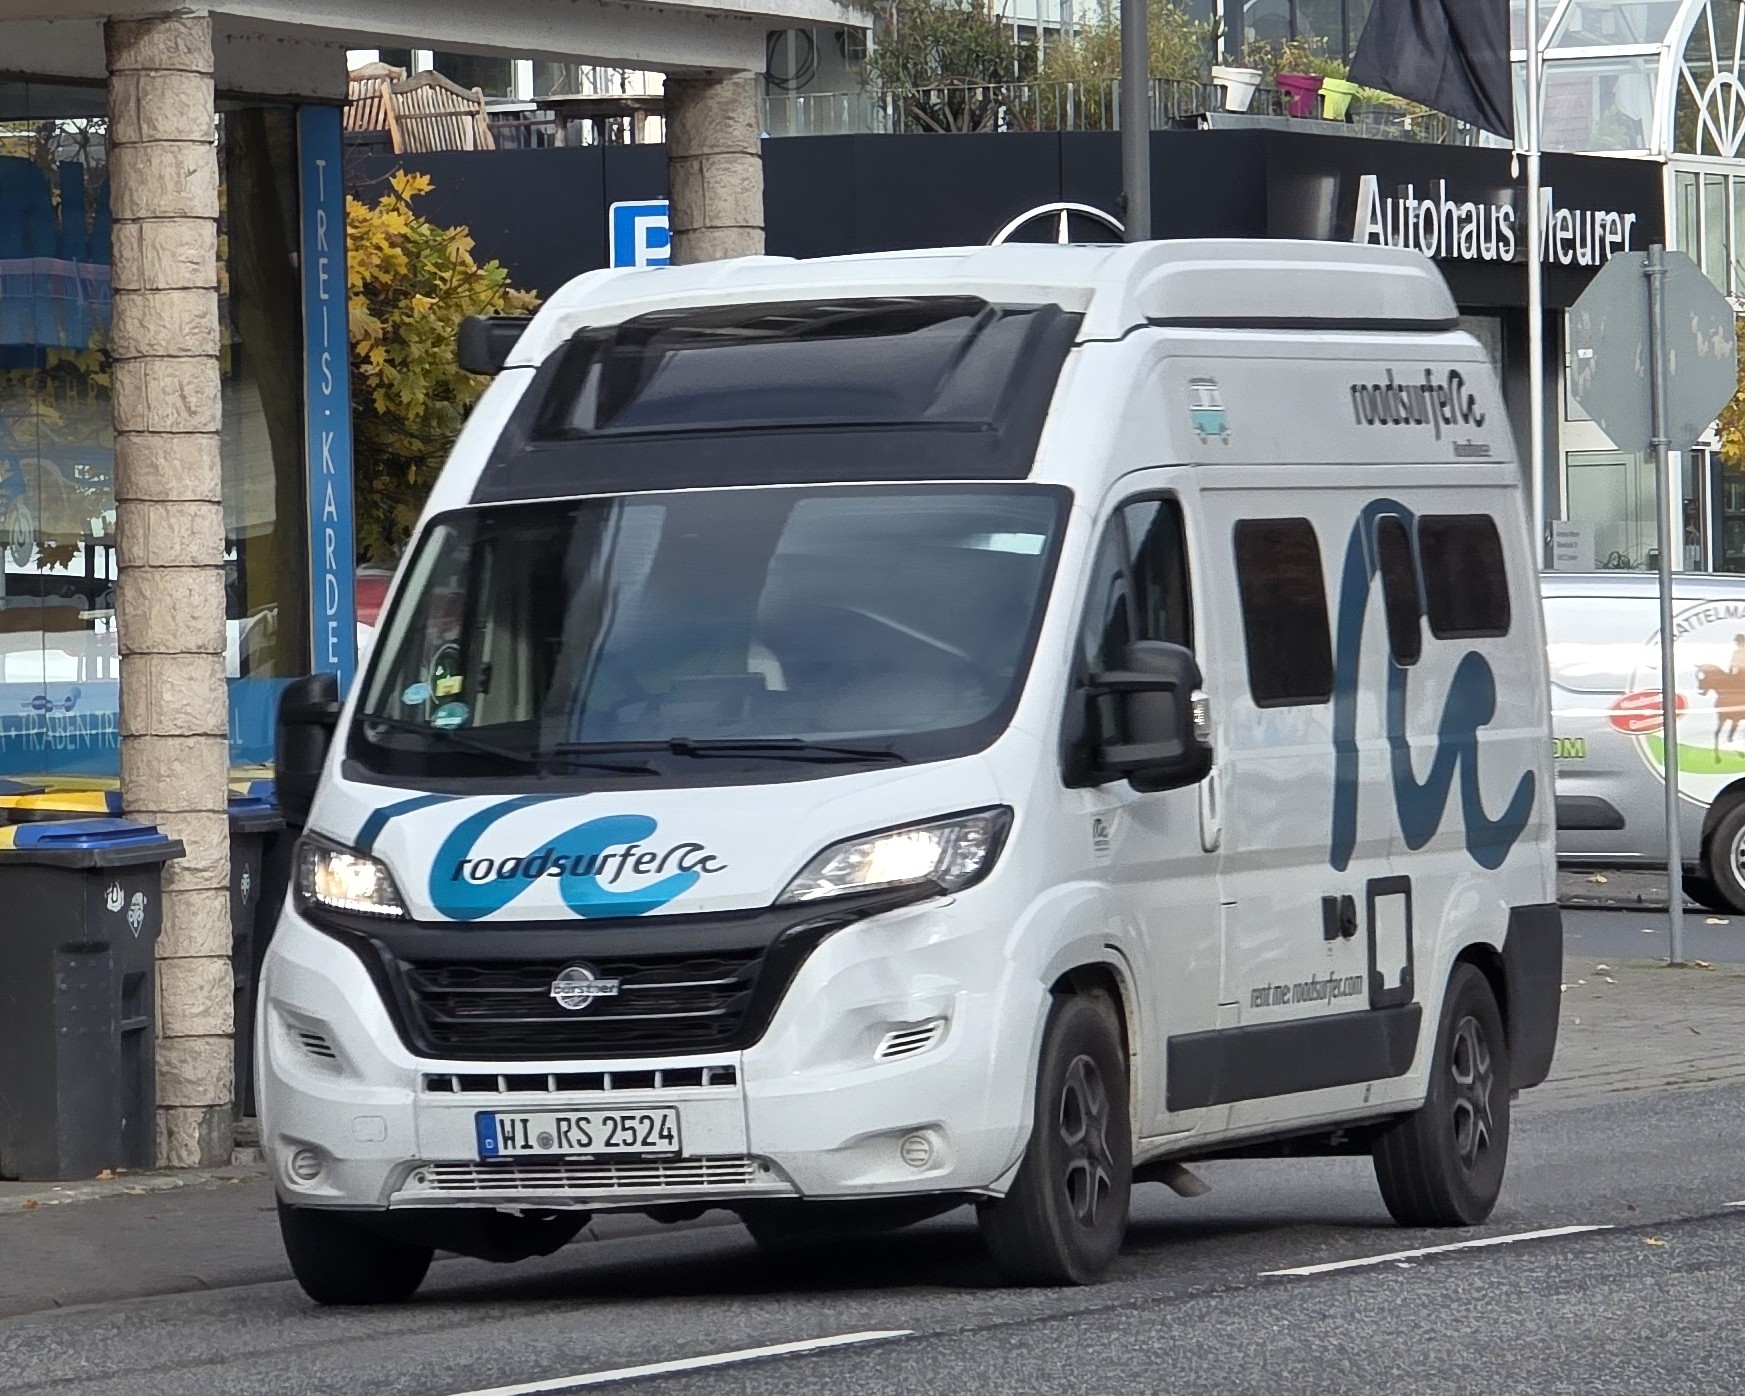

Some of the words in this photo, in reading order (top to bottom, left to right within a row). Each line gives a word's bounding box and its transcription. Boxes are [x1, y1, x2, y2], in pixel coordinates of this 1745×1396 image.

[634, 215, 671, 268] P
[1352, 174, 1515, 262] Autohaus
[452, 842, 729, 885] roadsurfer
[499, 1118, 534, 1151] WI
[555, 1116, 593, 1149] RS
[602, 1114, 675, 1148] 2524
